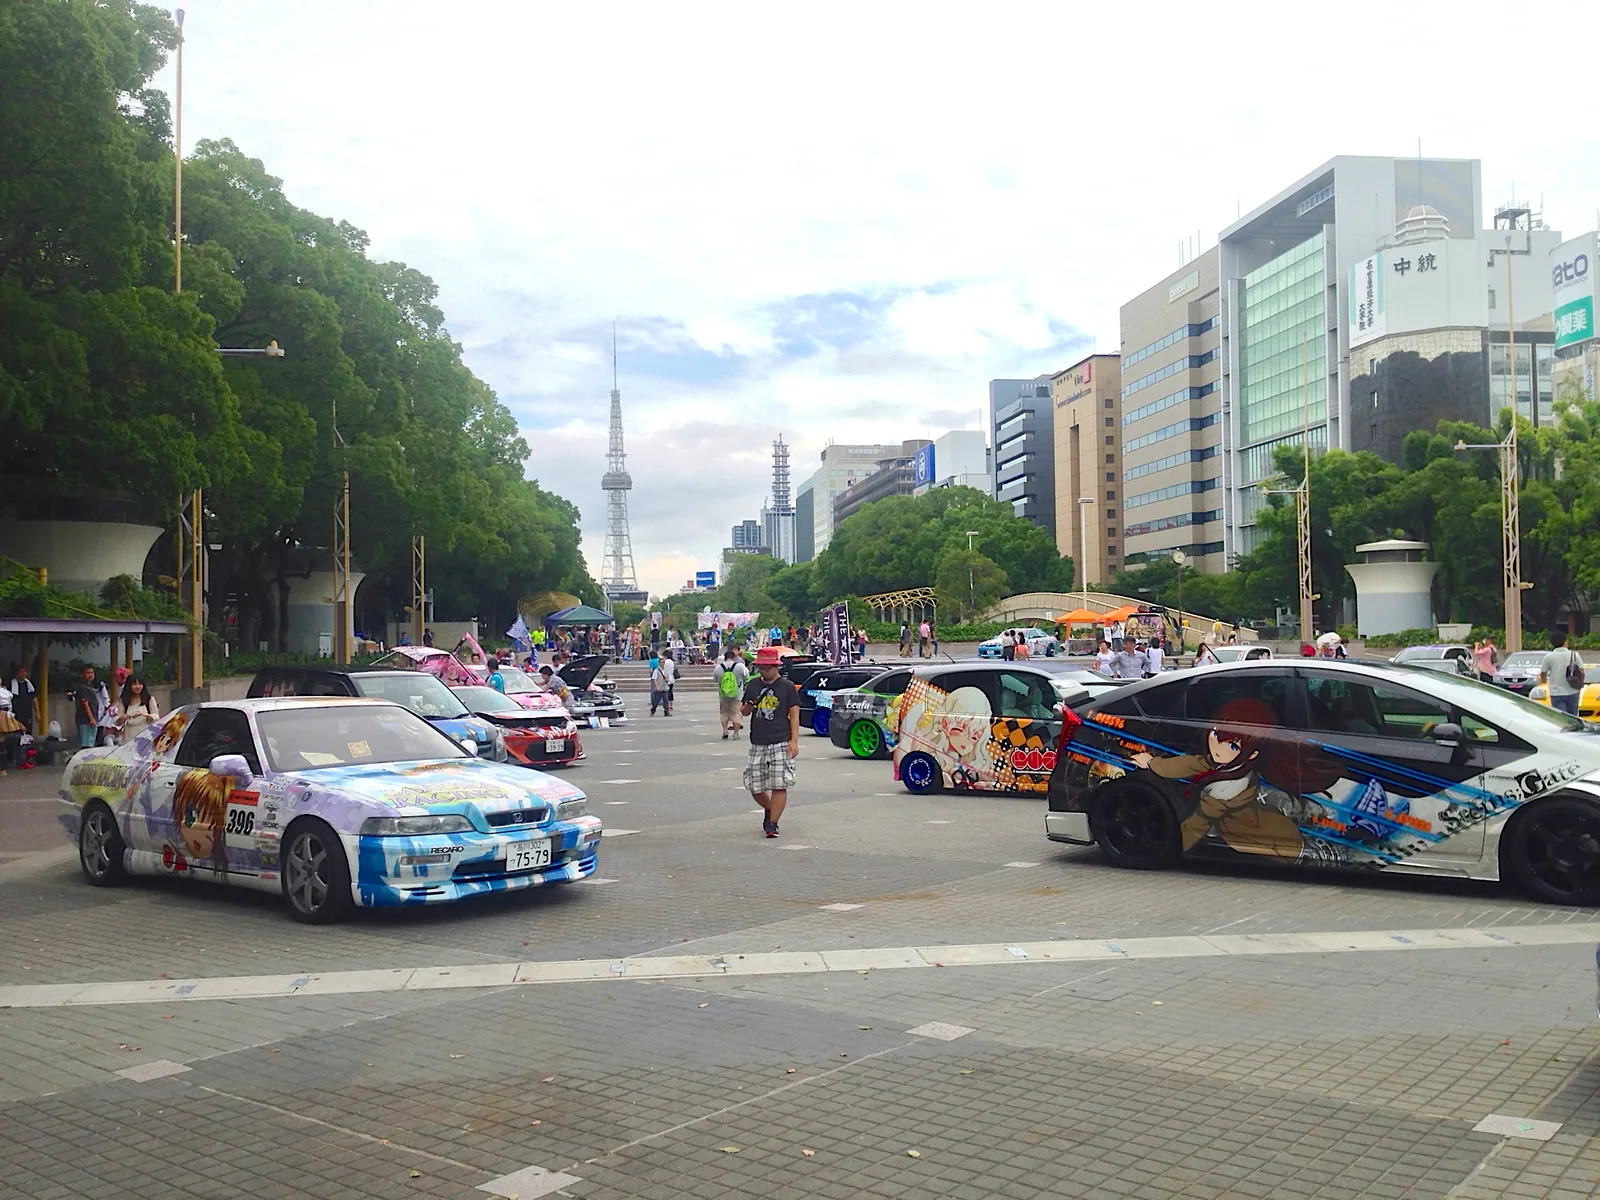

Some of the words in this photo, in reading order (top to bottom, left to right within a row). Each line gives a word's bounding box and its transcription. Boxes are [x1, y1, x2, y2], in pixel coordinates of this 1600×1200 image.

[1393, 253, 1438, 276] 中統
[1552, 253, 1588, 287] ato
[839, 610, 847, 635] THE
[389, 789, 509, 808] RACING
[226, 809, 255, 836] 396
[430, 845, 465, 854] RECARO
[531, 840, 541, 850] 302
[516, 849, 550, 868] 75-79
